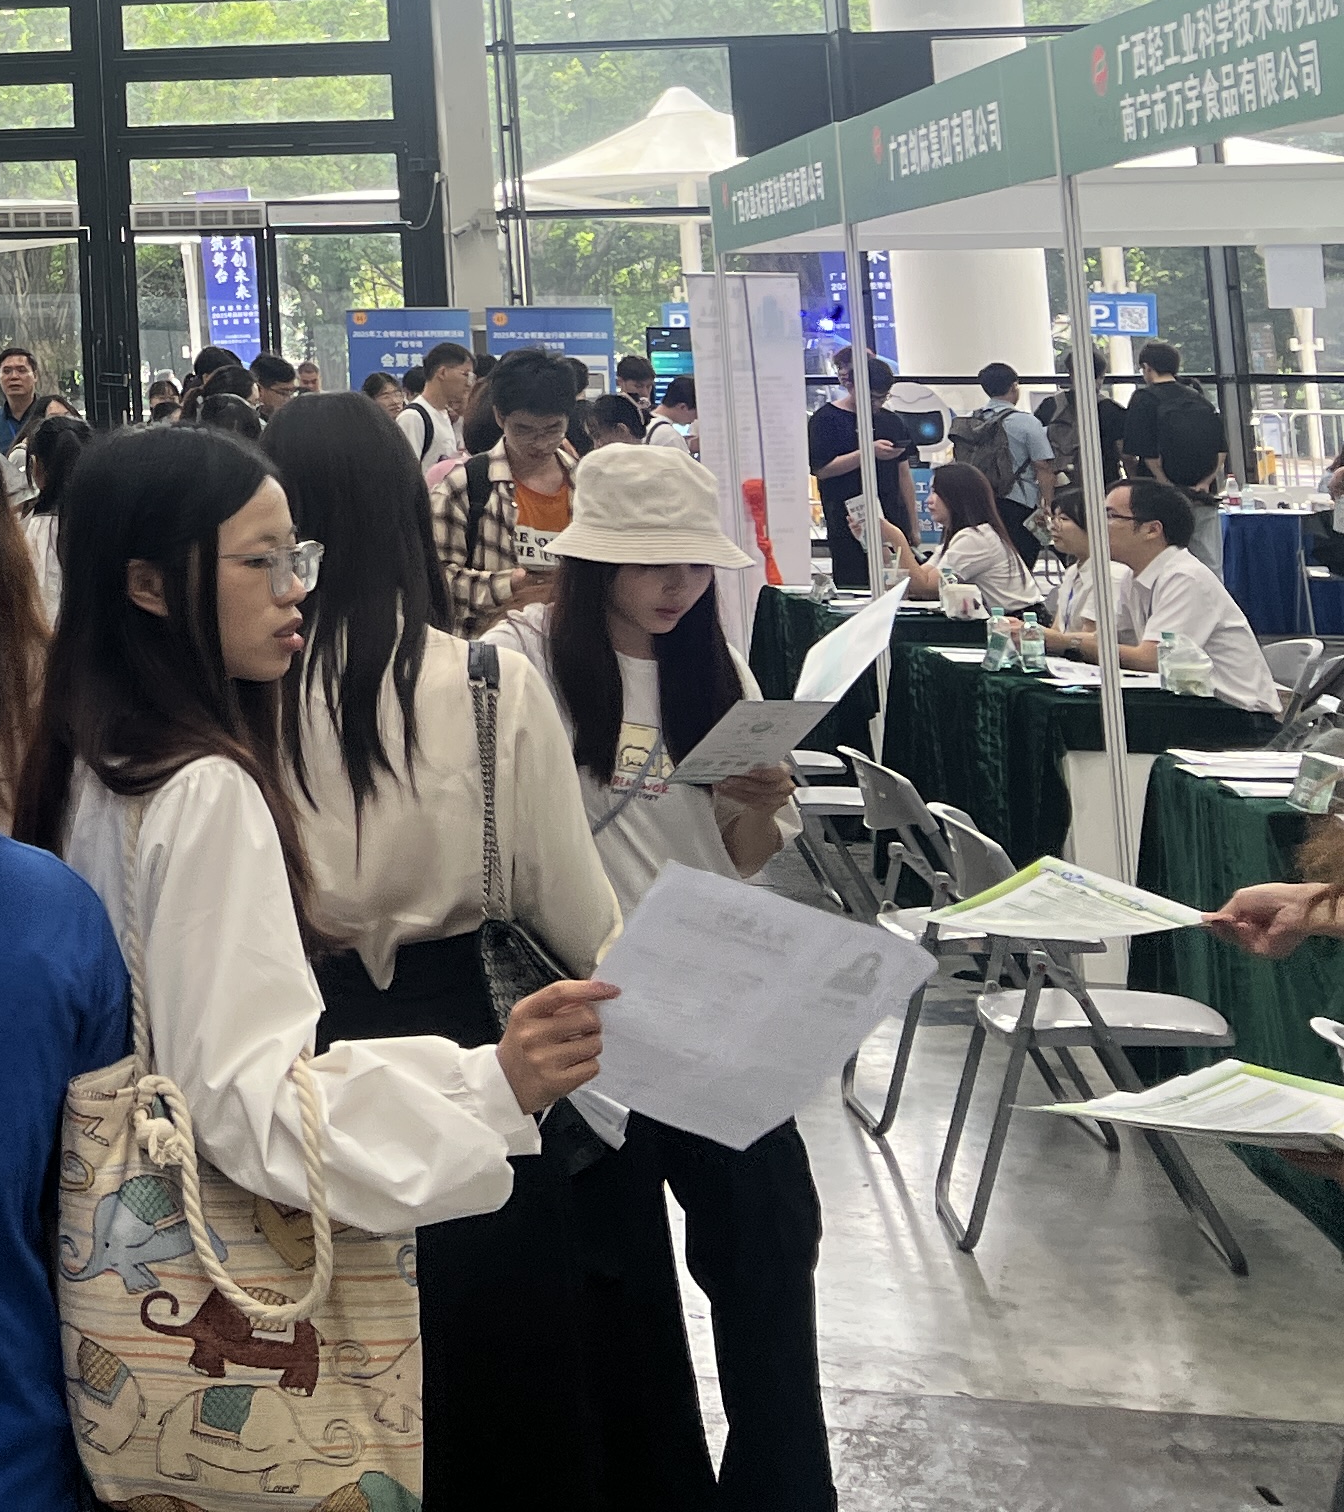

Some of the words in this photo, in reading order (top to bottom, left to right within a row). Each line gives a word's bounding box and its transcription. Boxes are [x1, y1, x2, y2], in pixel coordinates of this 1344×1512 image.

[1120, 40, 1321, 142] 南宁市万宇食品有限公司
[889, 101, 1002, 181] 广西剑麻集团有限公司
